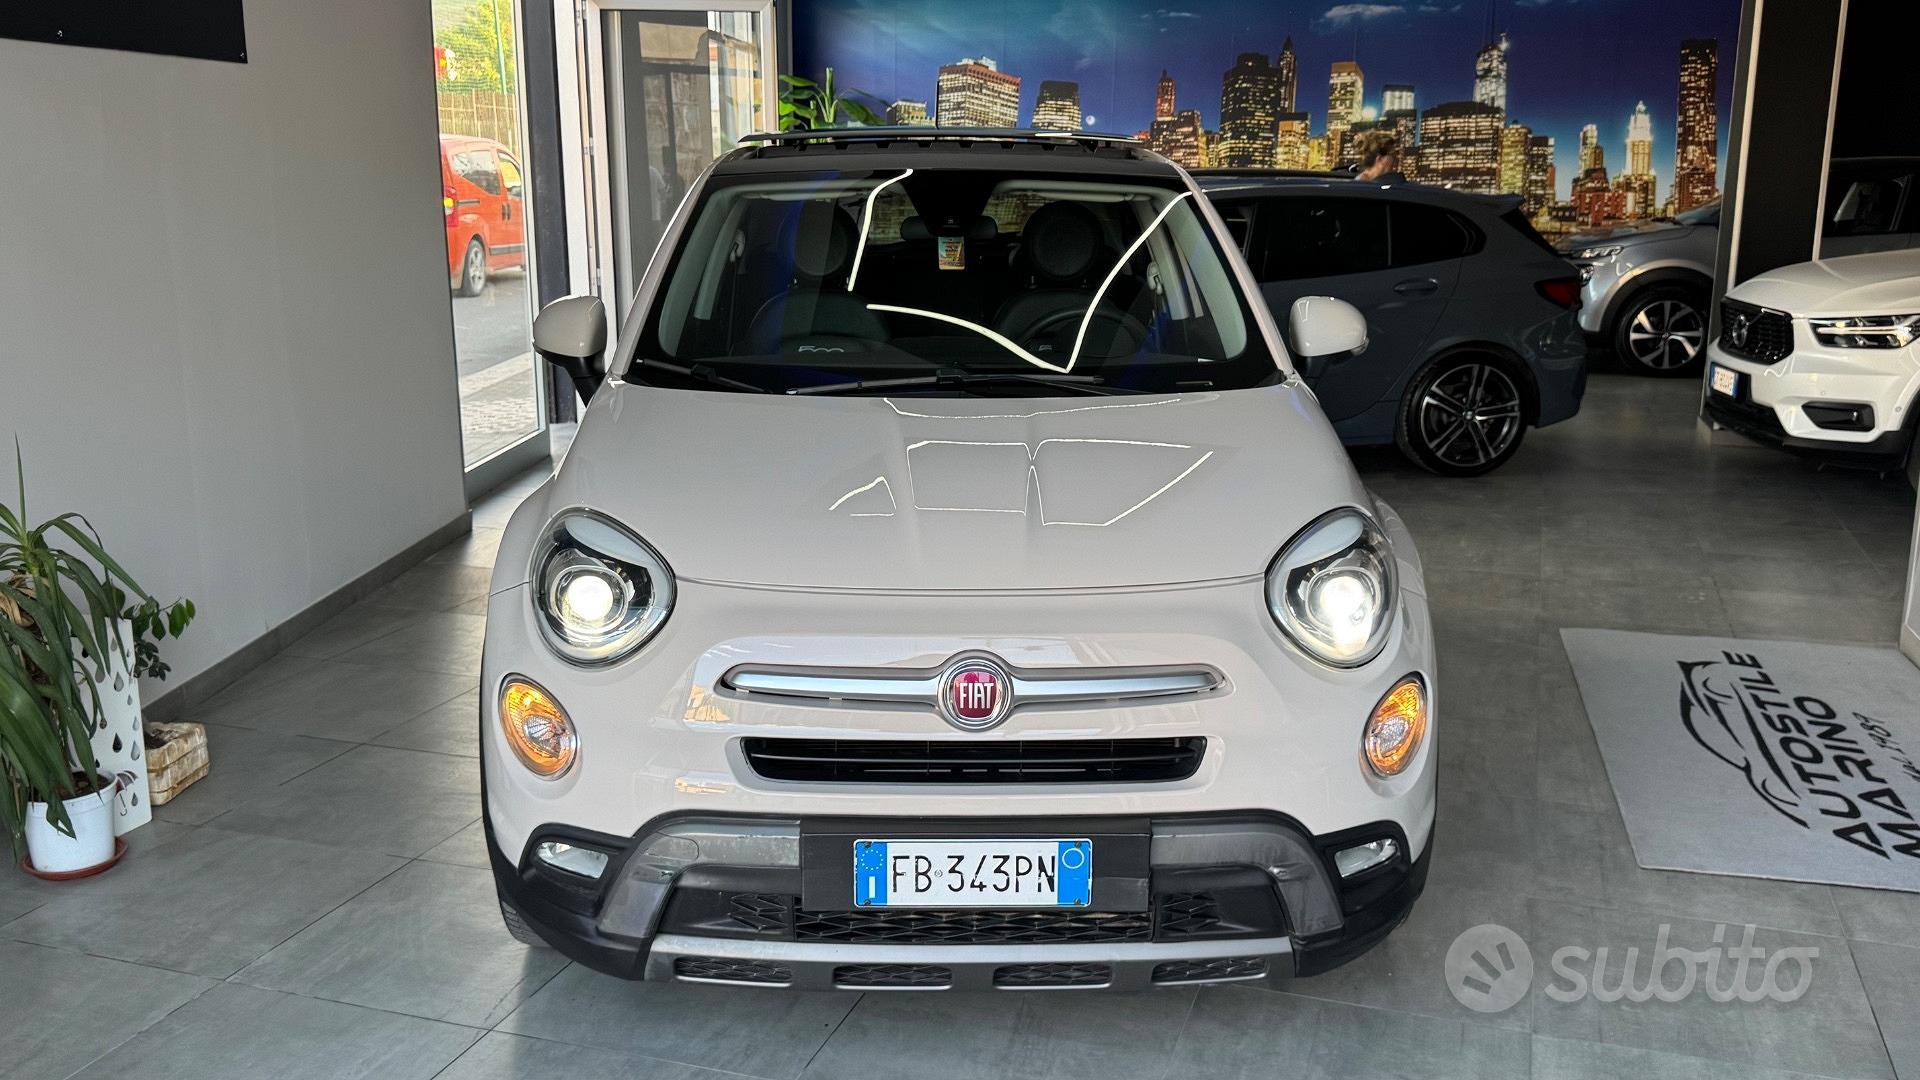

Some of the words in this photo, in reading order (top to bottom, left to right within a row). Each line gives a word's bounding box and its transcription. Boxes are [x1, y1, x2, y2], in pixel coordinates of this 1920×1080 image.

[960, 683, 994, 709] FIAT
[1721, 650, 1890, 860] AUTOSTILE
[1793, 696, 1920, 859] MARINO
